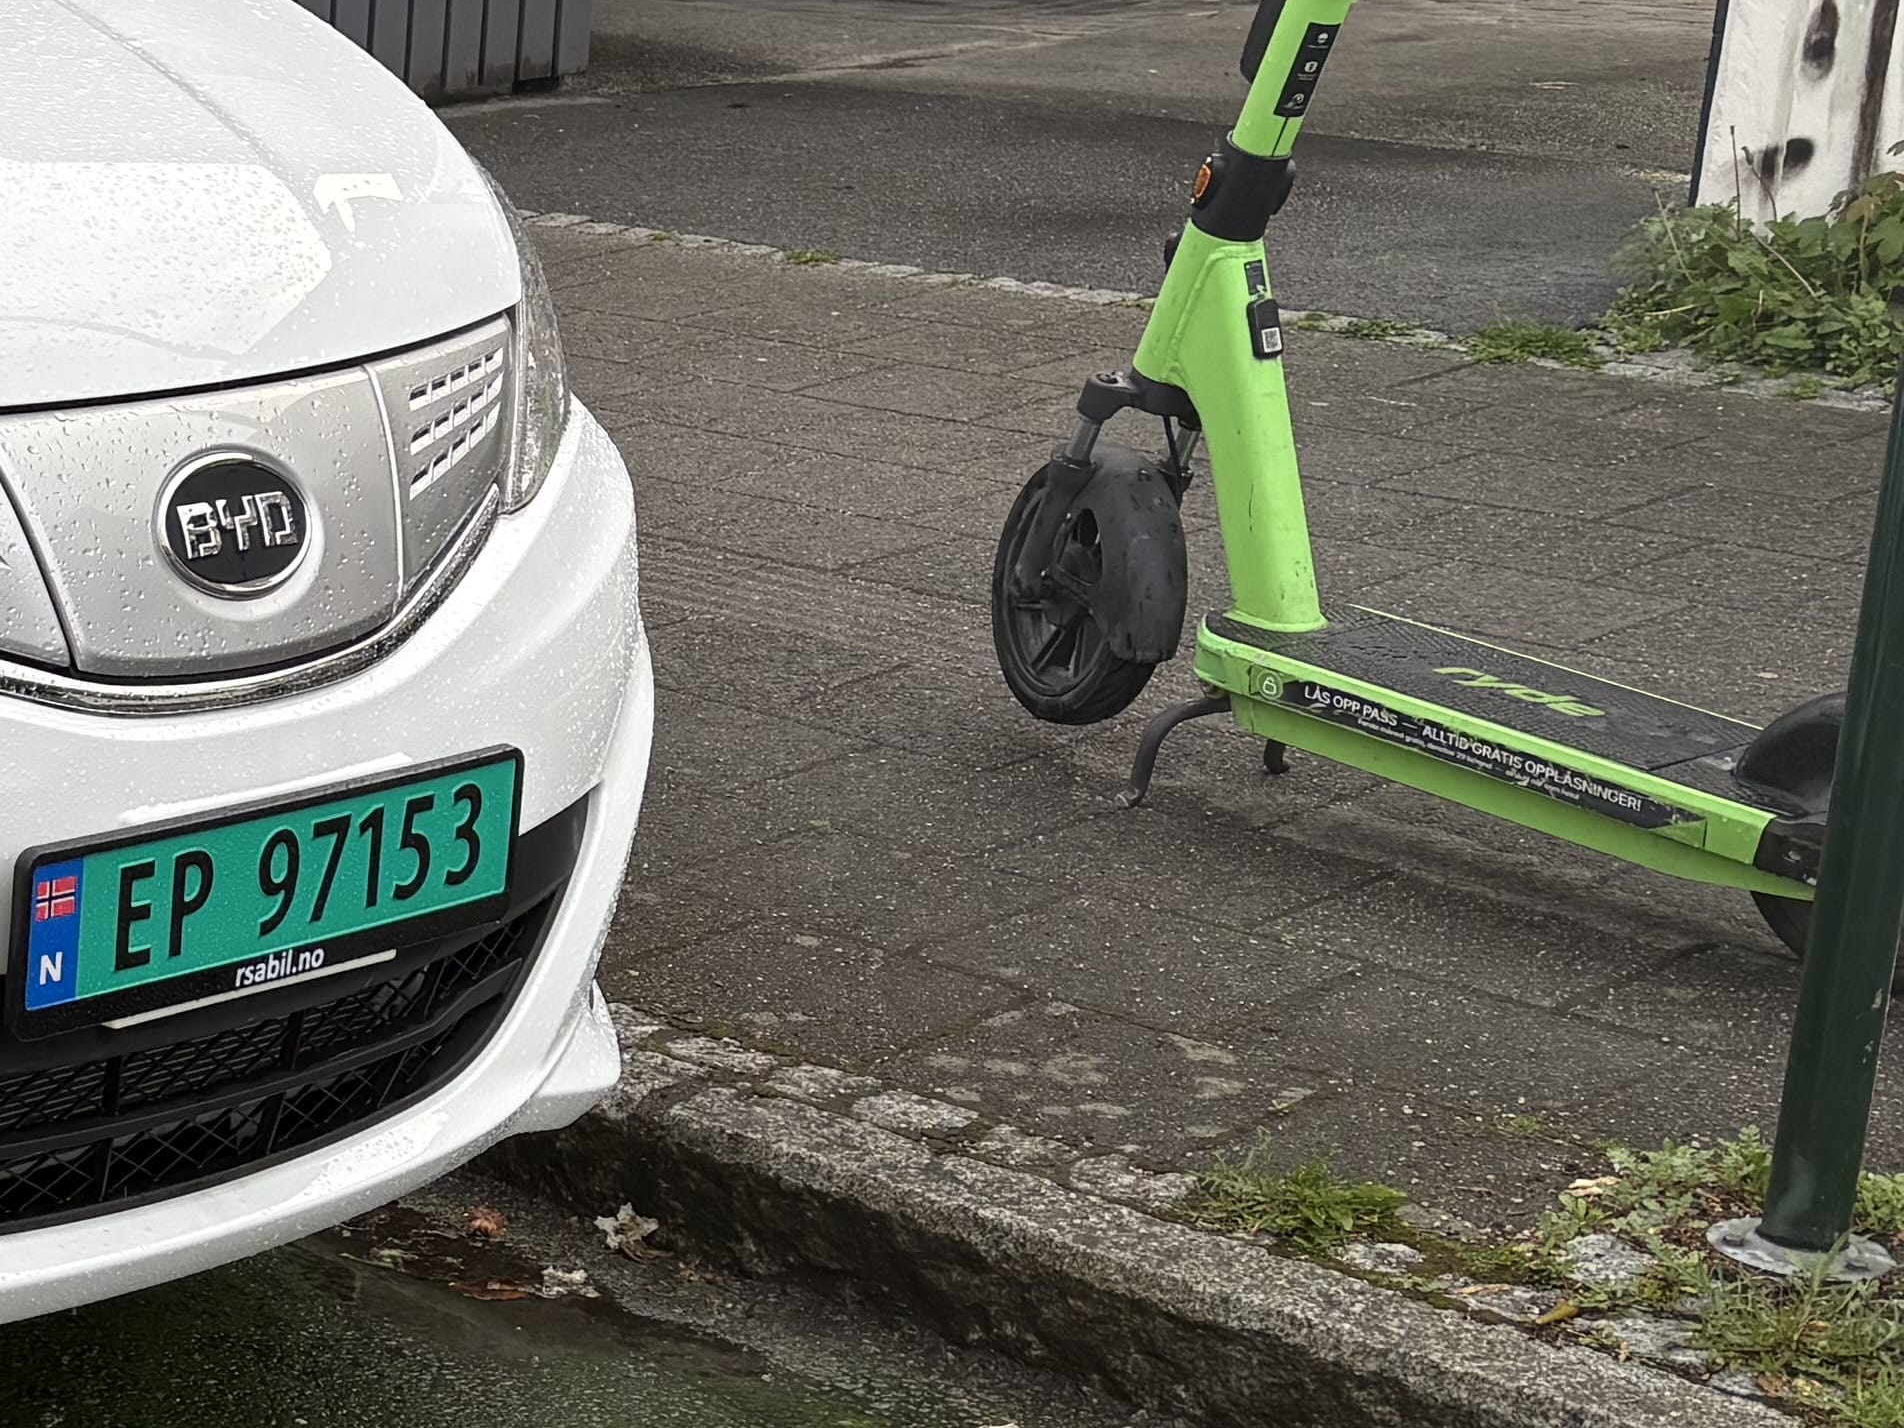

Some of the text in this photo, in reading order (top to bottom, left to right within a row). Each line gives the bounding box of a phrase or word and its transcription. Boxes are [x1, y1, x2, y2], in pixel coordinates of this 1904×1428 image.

[176, 489, 299, 560] BYD
[1432, 667, 1605, 717] ryde
[1304, 684, 1330, 704] LÅS
[1333, 695, 1360, 713] OPP
[1362, 705, 1398, 727] PASS
[1422, 726, 1468, 750] ALLTID
[1472, 742, 1524, 770] GRATIS
[113, 783, 483, 972] EP 97153
[38, 954, 63, 986] N
[235, 948, 325, 988] rsabil.no
